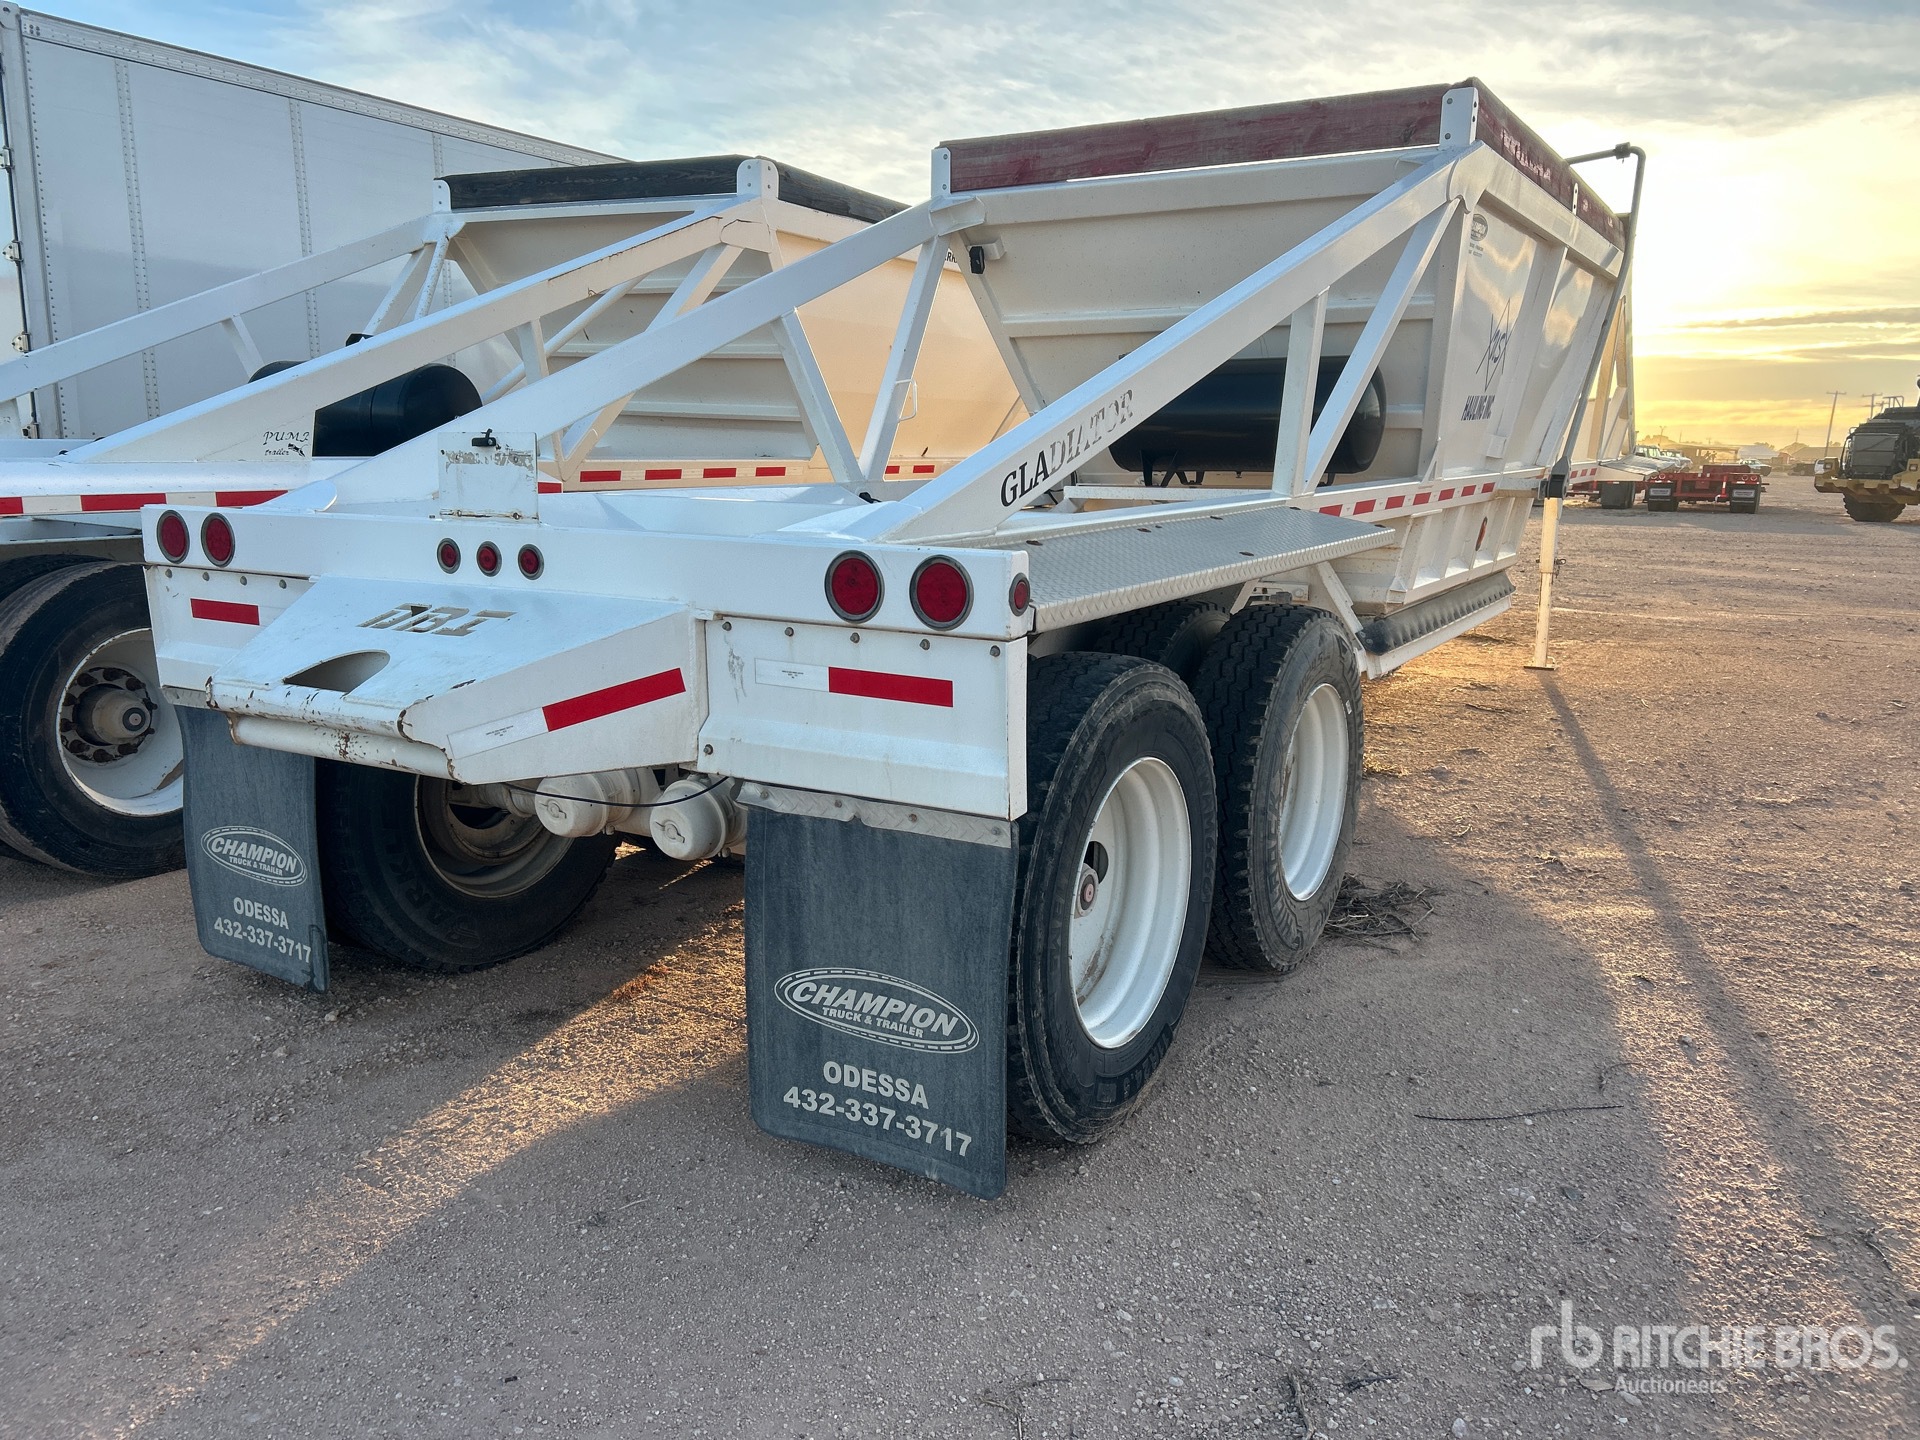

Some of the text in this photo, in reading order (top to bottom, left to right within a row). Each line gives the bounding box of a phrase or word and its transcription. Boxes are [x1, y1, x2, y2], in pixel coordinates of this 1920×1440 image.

[211, 837, 297, 873] CHAMPION
[229, 856, 252, 868] TRUCK
[259, 863, 283, 876] TRAILER
[233, 897, 289, 929] ODESSA
[214, 917, 311, 963] 432-337-3717
[792, 981, 959, 1037] CHAMPION
[822, 1006, 924, 1038] TRUCK & TRAILER
[823, 1061, 929, 1109] ODESSA
[783, 1086, 972, 1156] 432-337-3717
